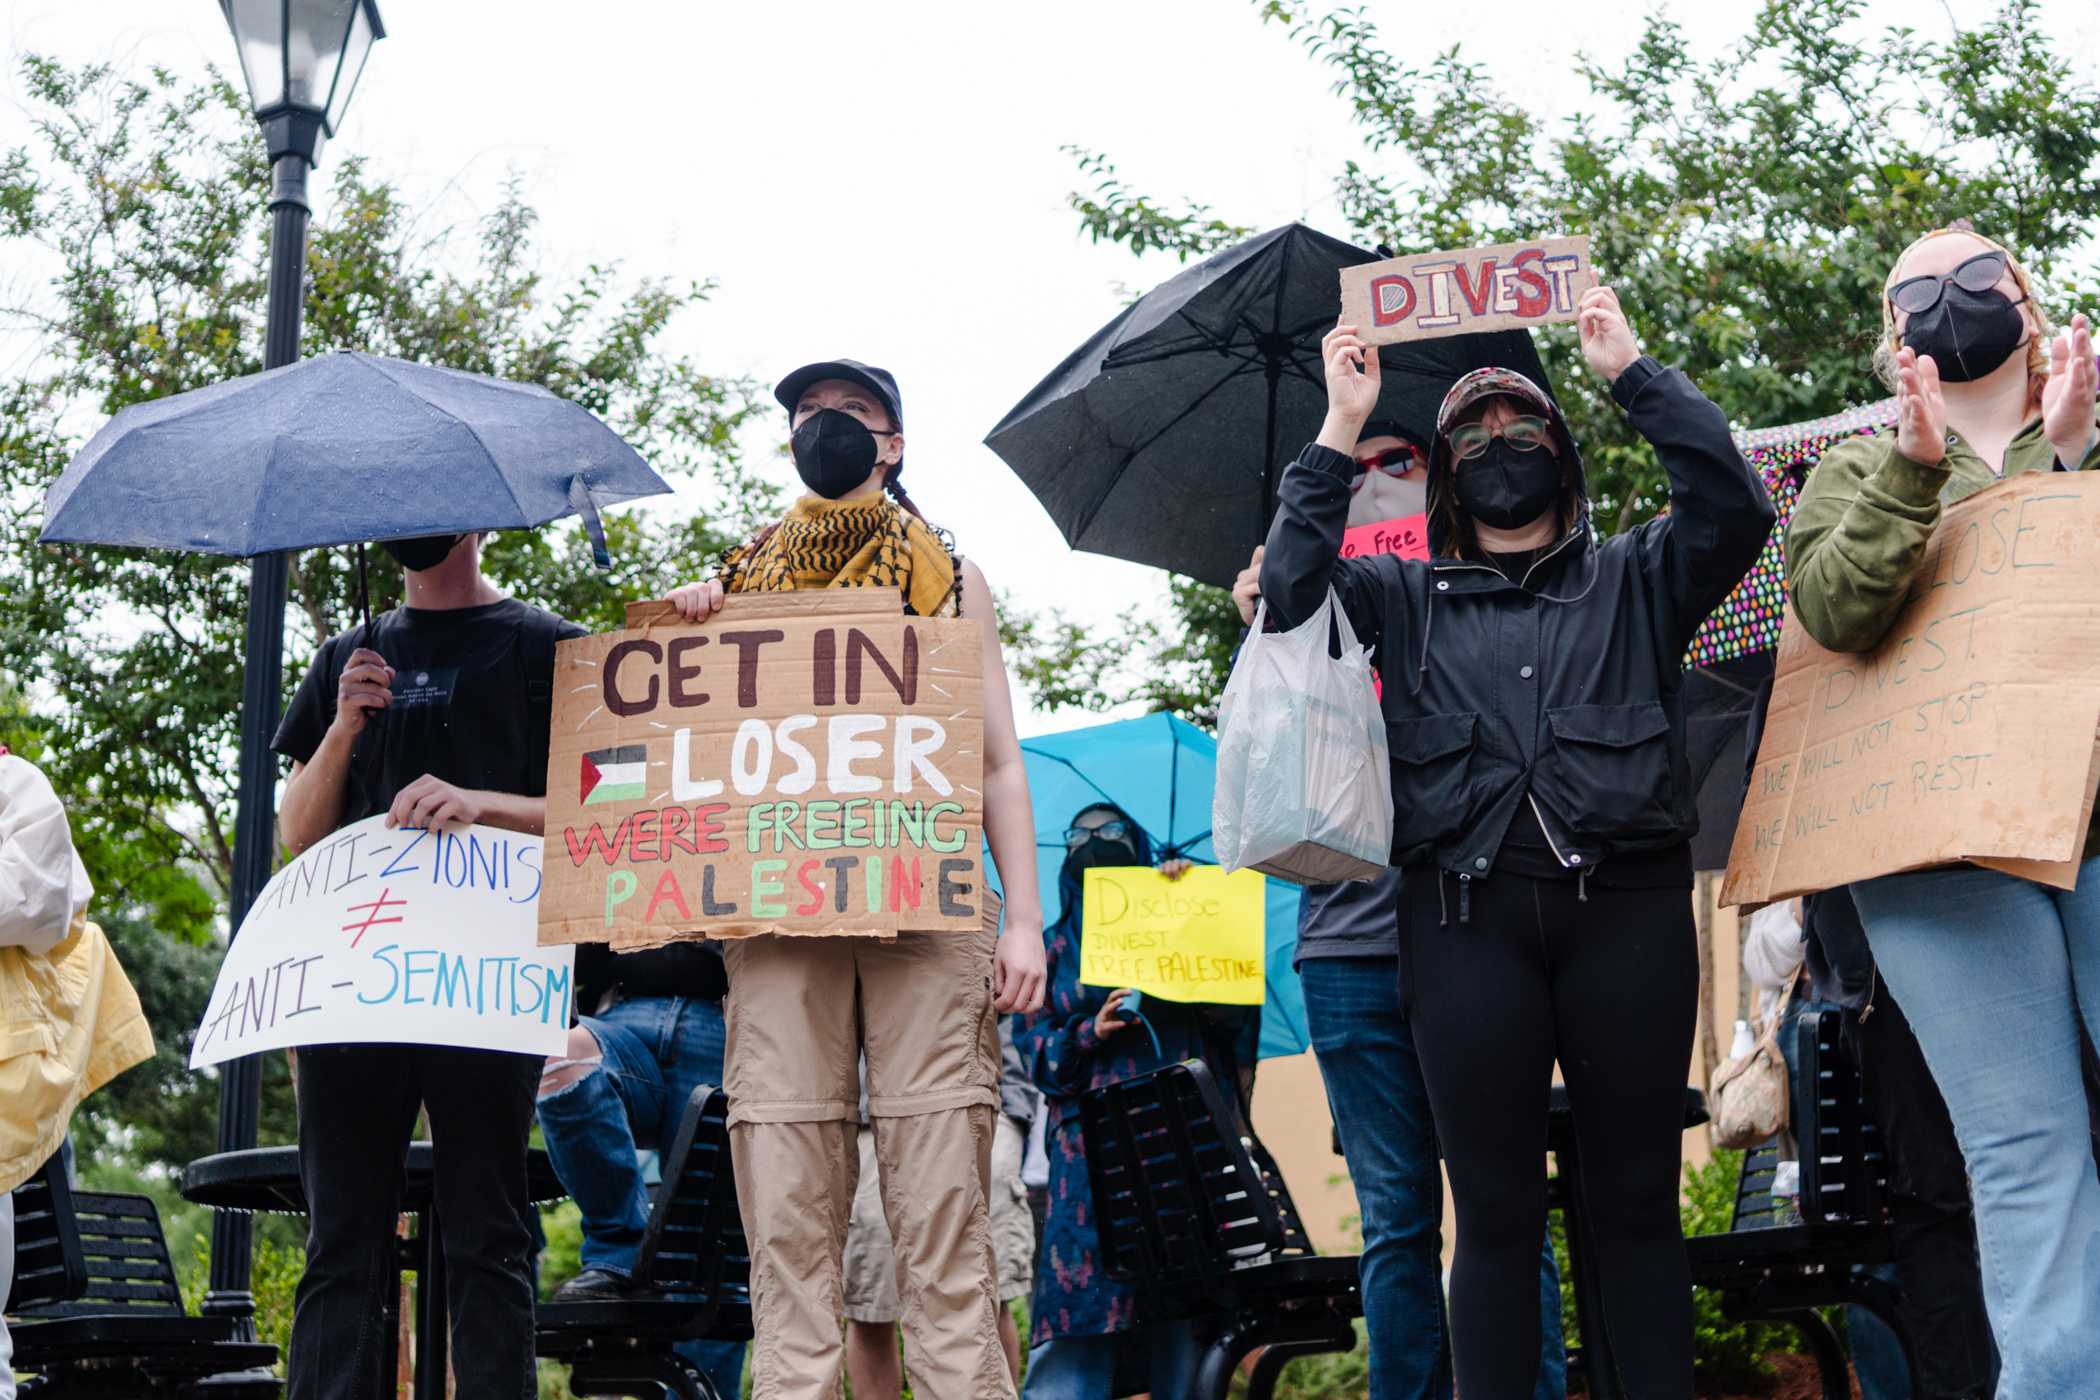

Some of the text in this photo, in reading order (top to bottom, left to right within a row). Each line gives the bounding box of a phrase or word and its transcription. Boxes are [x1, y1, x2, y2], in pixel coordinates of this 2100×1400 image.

[1371, 248, 1579, 328] DIVEST
[1374, 529, 1417, 556] Free
[602, 624, 920, 717] GET IN
[671, 713, 955, 802] LOSER
[1762, 680, 1987, 796] WE WILL NOT STOP
[563, 798, 967, 868] WERE FREEING
[1754, 818, 1785, 852] WE
[1794, 805, 1839, 840] WILL
[1848, 779, 1897, 818] NOT
[255, 825, 543, 921] ANTI-ZIONIS
[604, 855, 977, 929] PALESTINE
[1088, 951, 1262, 983] FREE PALESTINE
[1091, 930, 1170, 952] DIVEST
[200, 944, 570, 1053] ANTI-SEMITISM
